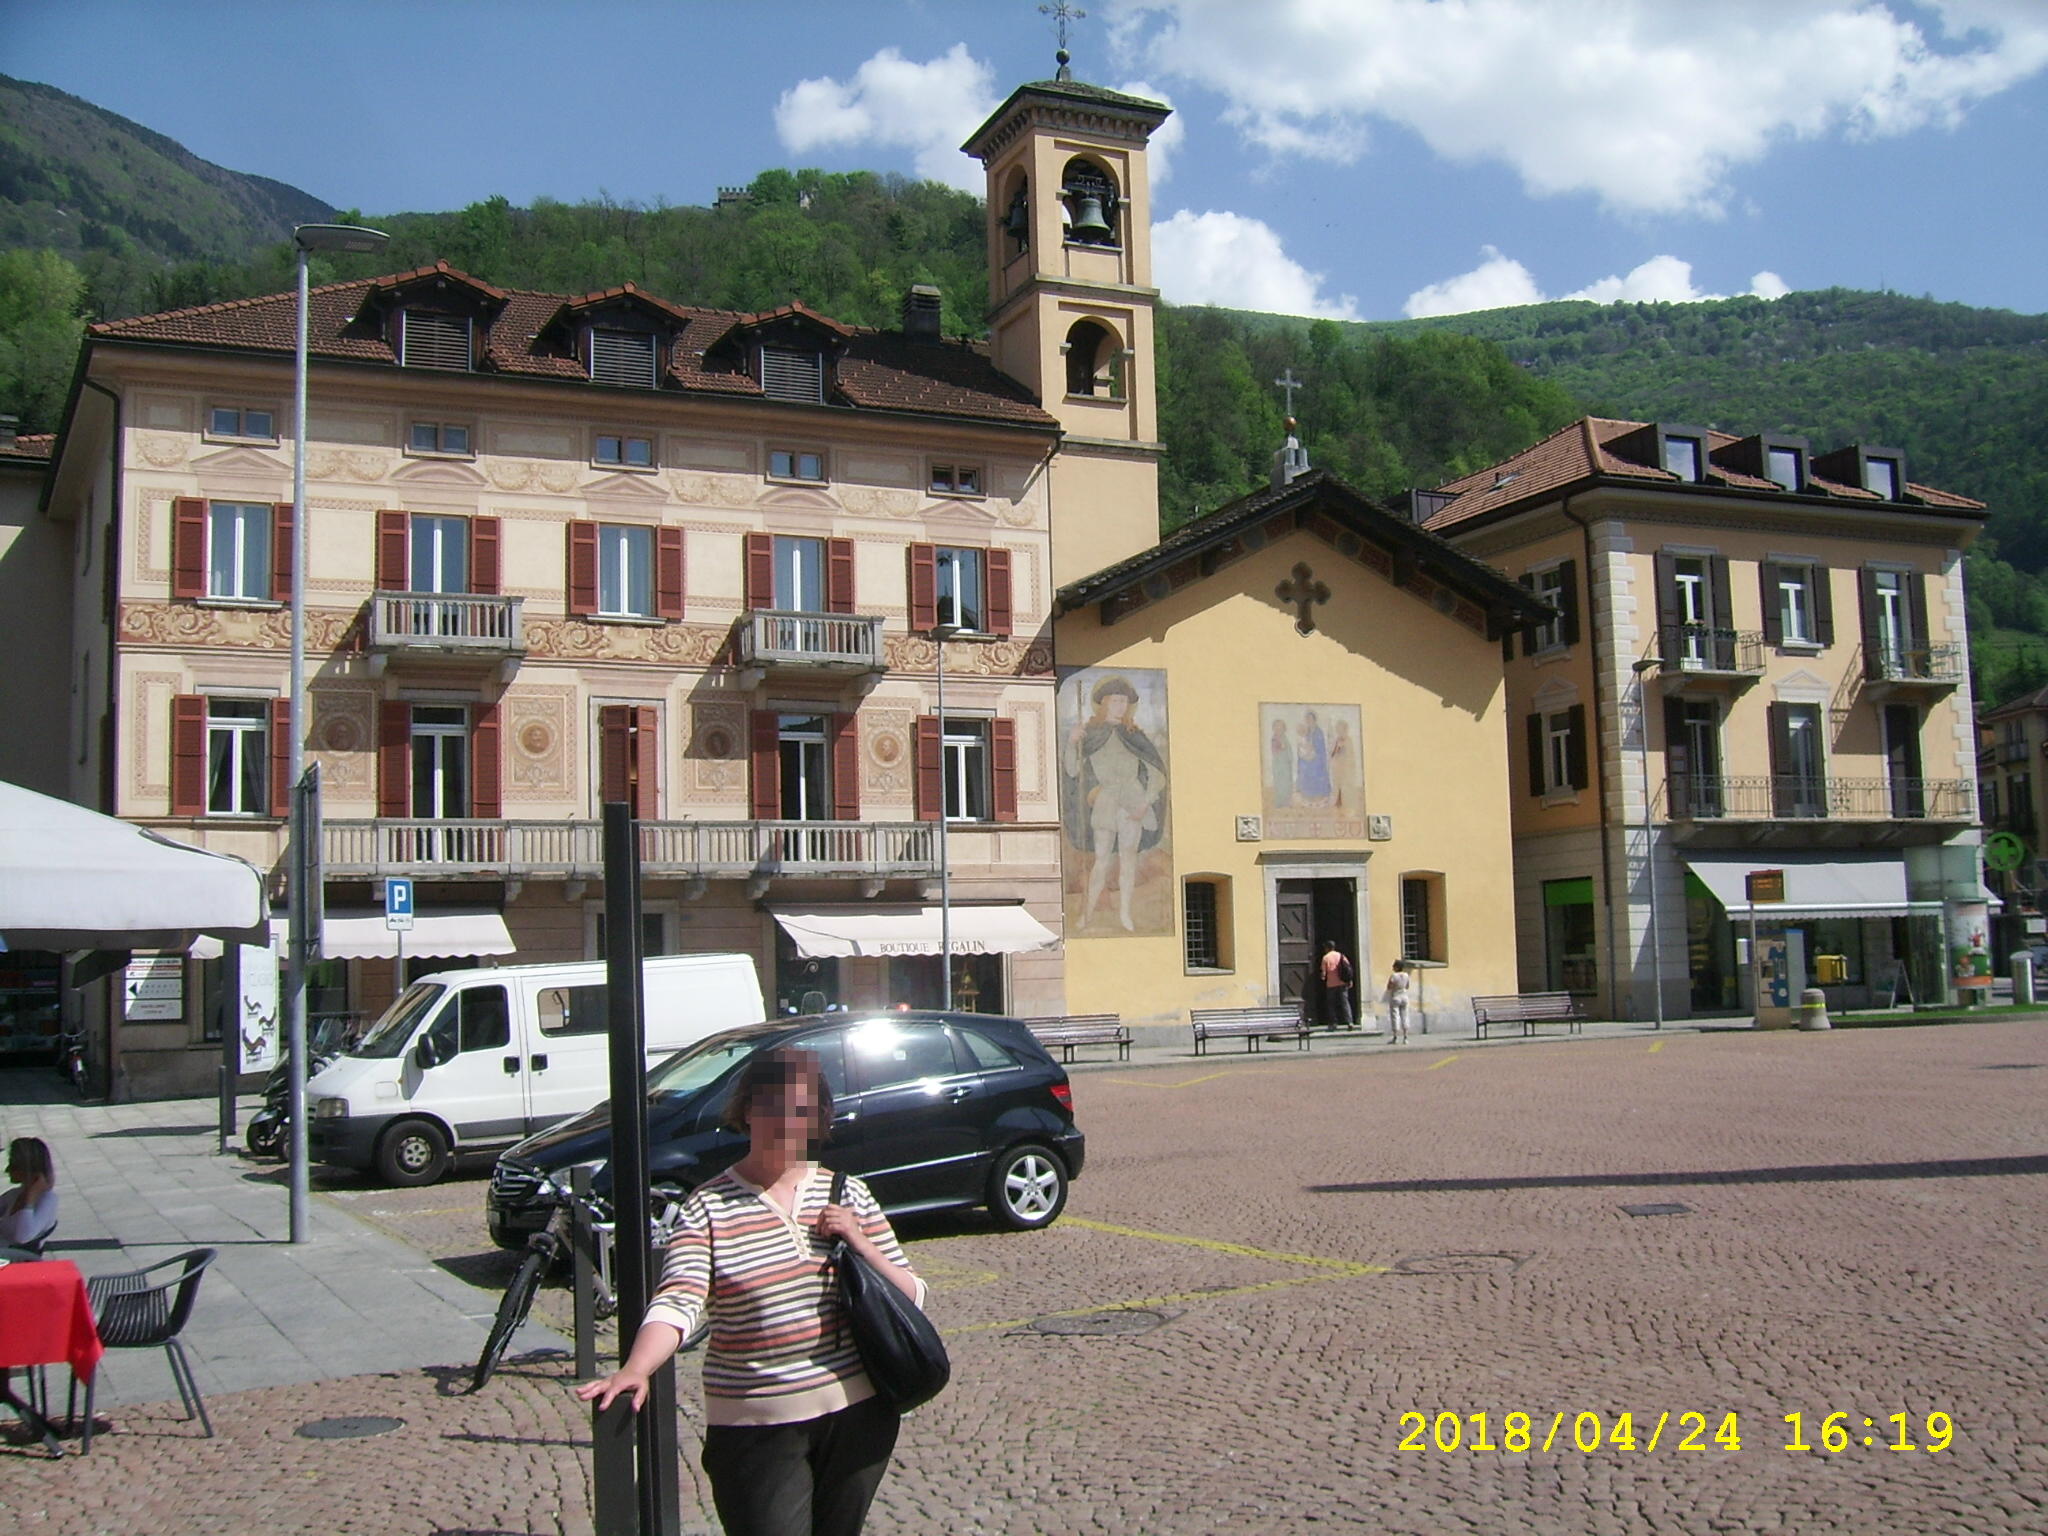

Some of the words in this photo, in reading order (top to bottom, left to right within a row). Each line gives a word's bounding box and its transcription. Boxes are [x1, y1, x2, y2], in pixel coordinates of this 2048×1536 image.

[394, 885, 406, 910] P
[880, 942, 929, 953] BOUTIQUE
[937, 940, 985, 952] RGALIN
